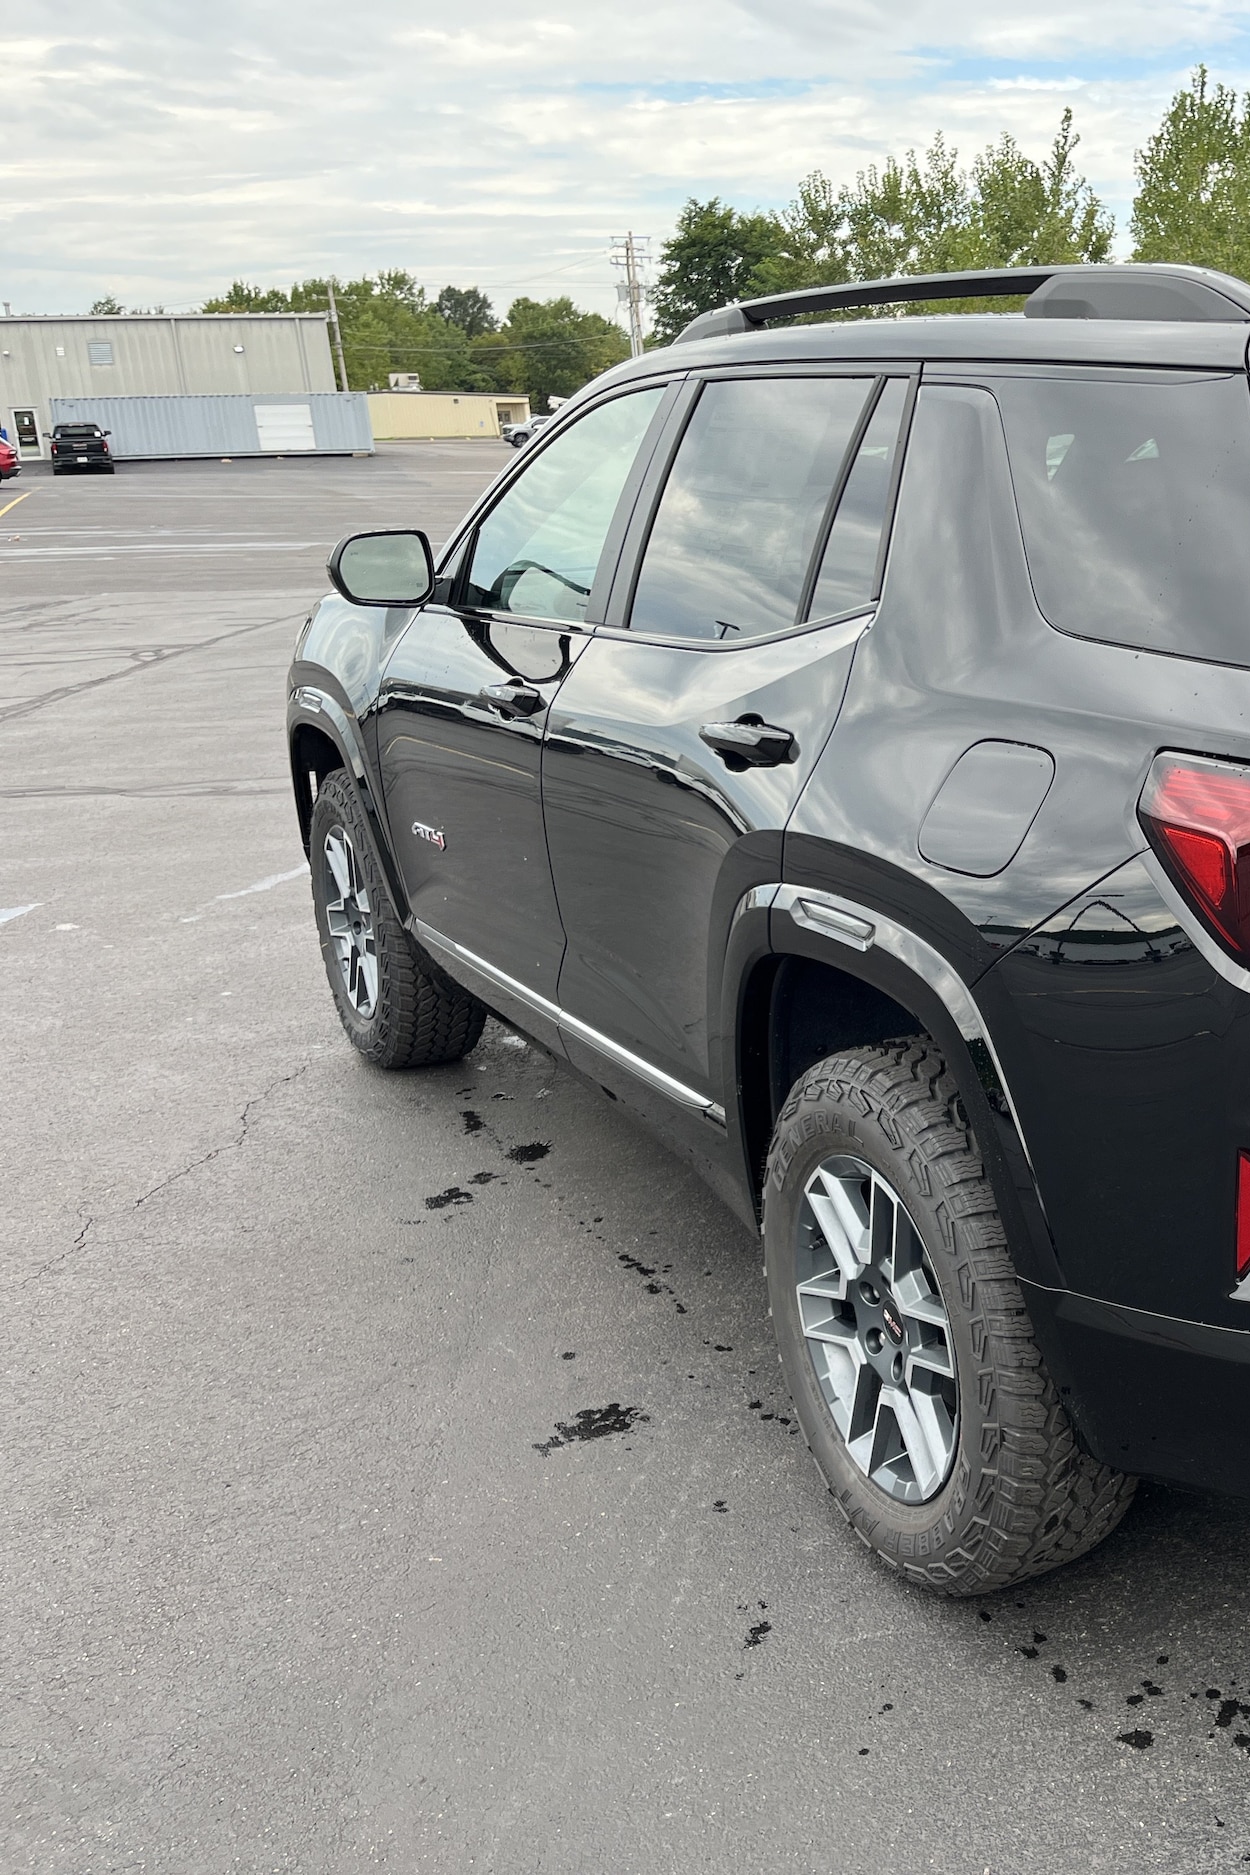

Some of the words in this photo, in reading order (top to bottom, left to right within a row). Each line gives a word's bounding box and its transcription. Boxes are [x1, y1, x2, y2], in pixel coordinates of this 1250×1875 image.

[410, 821, 446, 851] AT4
[773, 1108, 864, 1192] GENERAL
[884, 1449, 972, 1557] GRABBER
